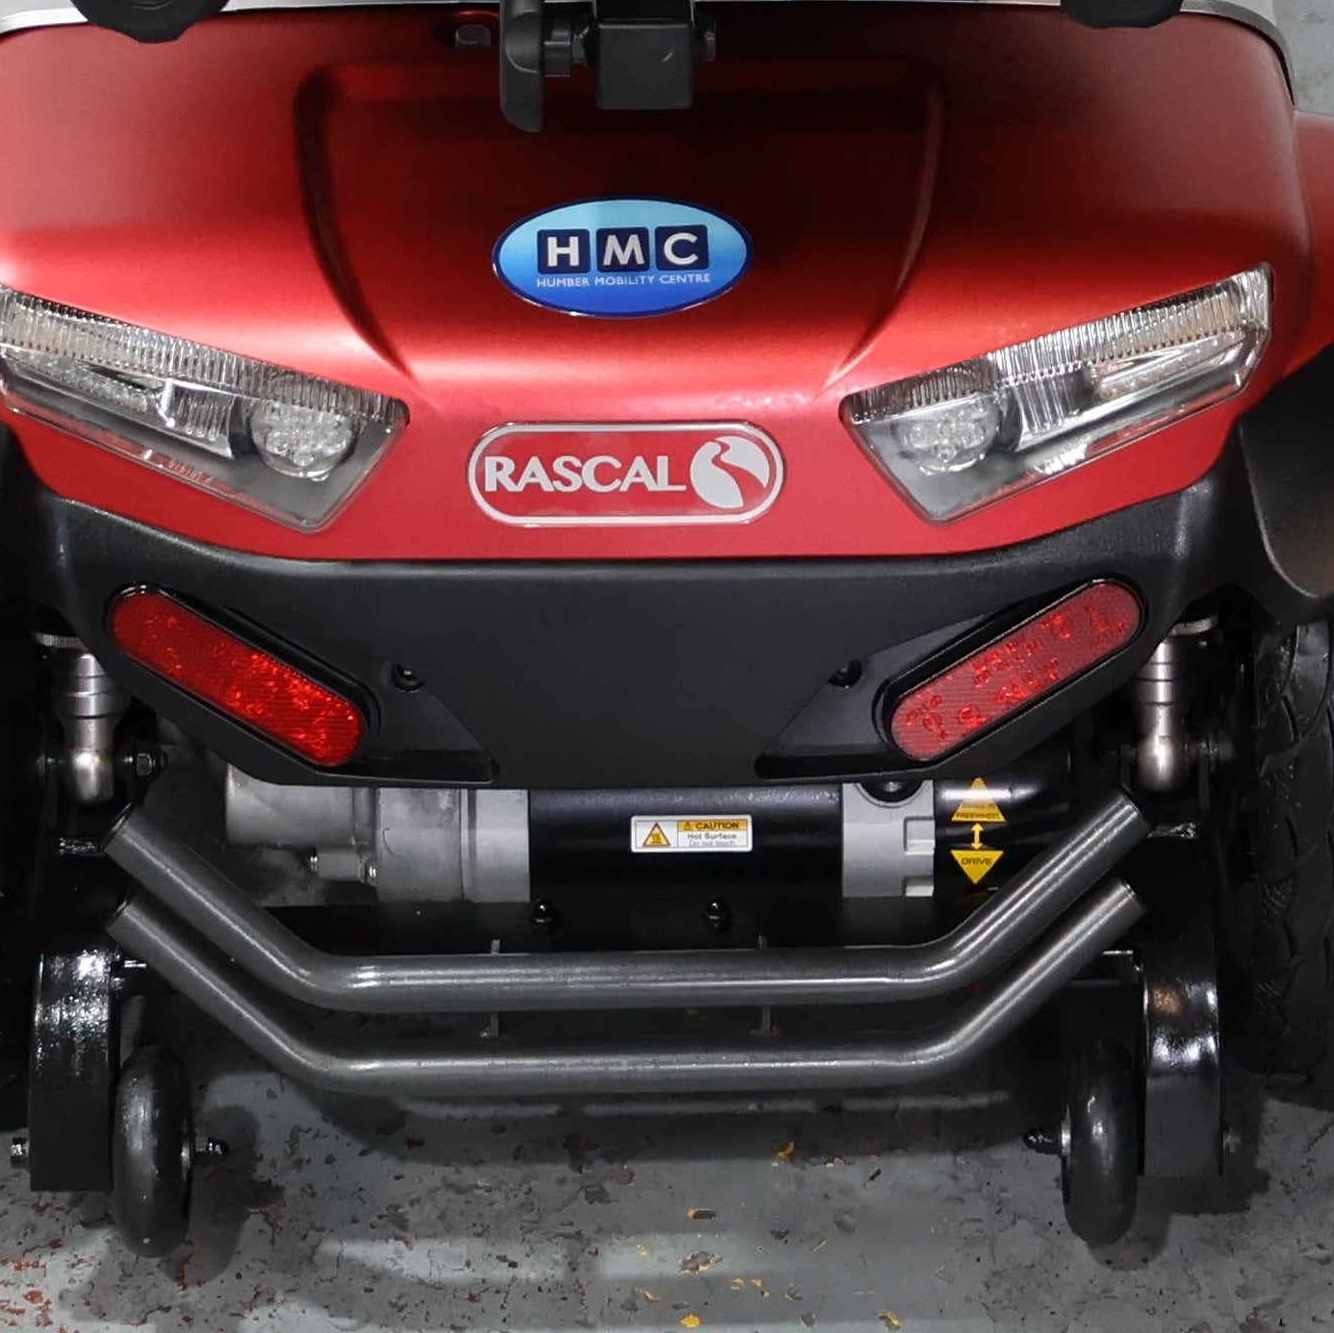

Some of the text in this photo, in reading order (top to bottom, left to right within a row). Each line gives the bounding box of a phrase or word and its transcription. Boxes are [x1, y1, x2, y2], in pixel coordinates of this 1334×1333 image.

[547, 232, 698, 268] HMC
[536, 273, 710, 288] HUMBER MOBILITY CENTRE
[484, 455, 687, 492] RASCAL
[695, 821, 739, 830] CAUTION
[704, 832, 737, 840] Surface
[961, 857, 993, 866] DRIVE
